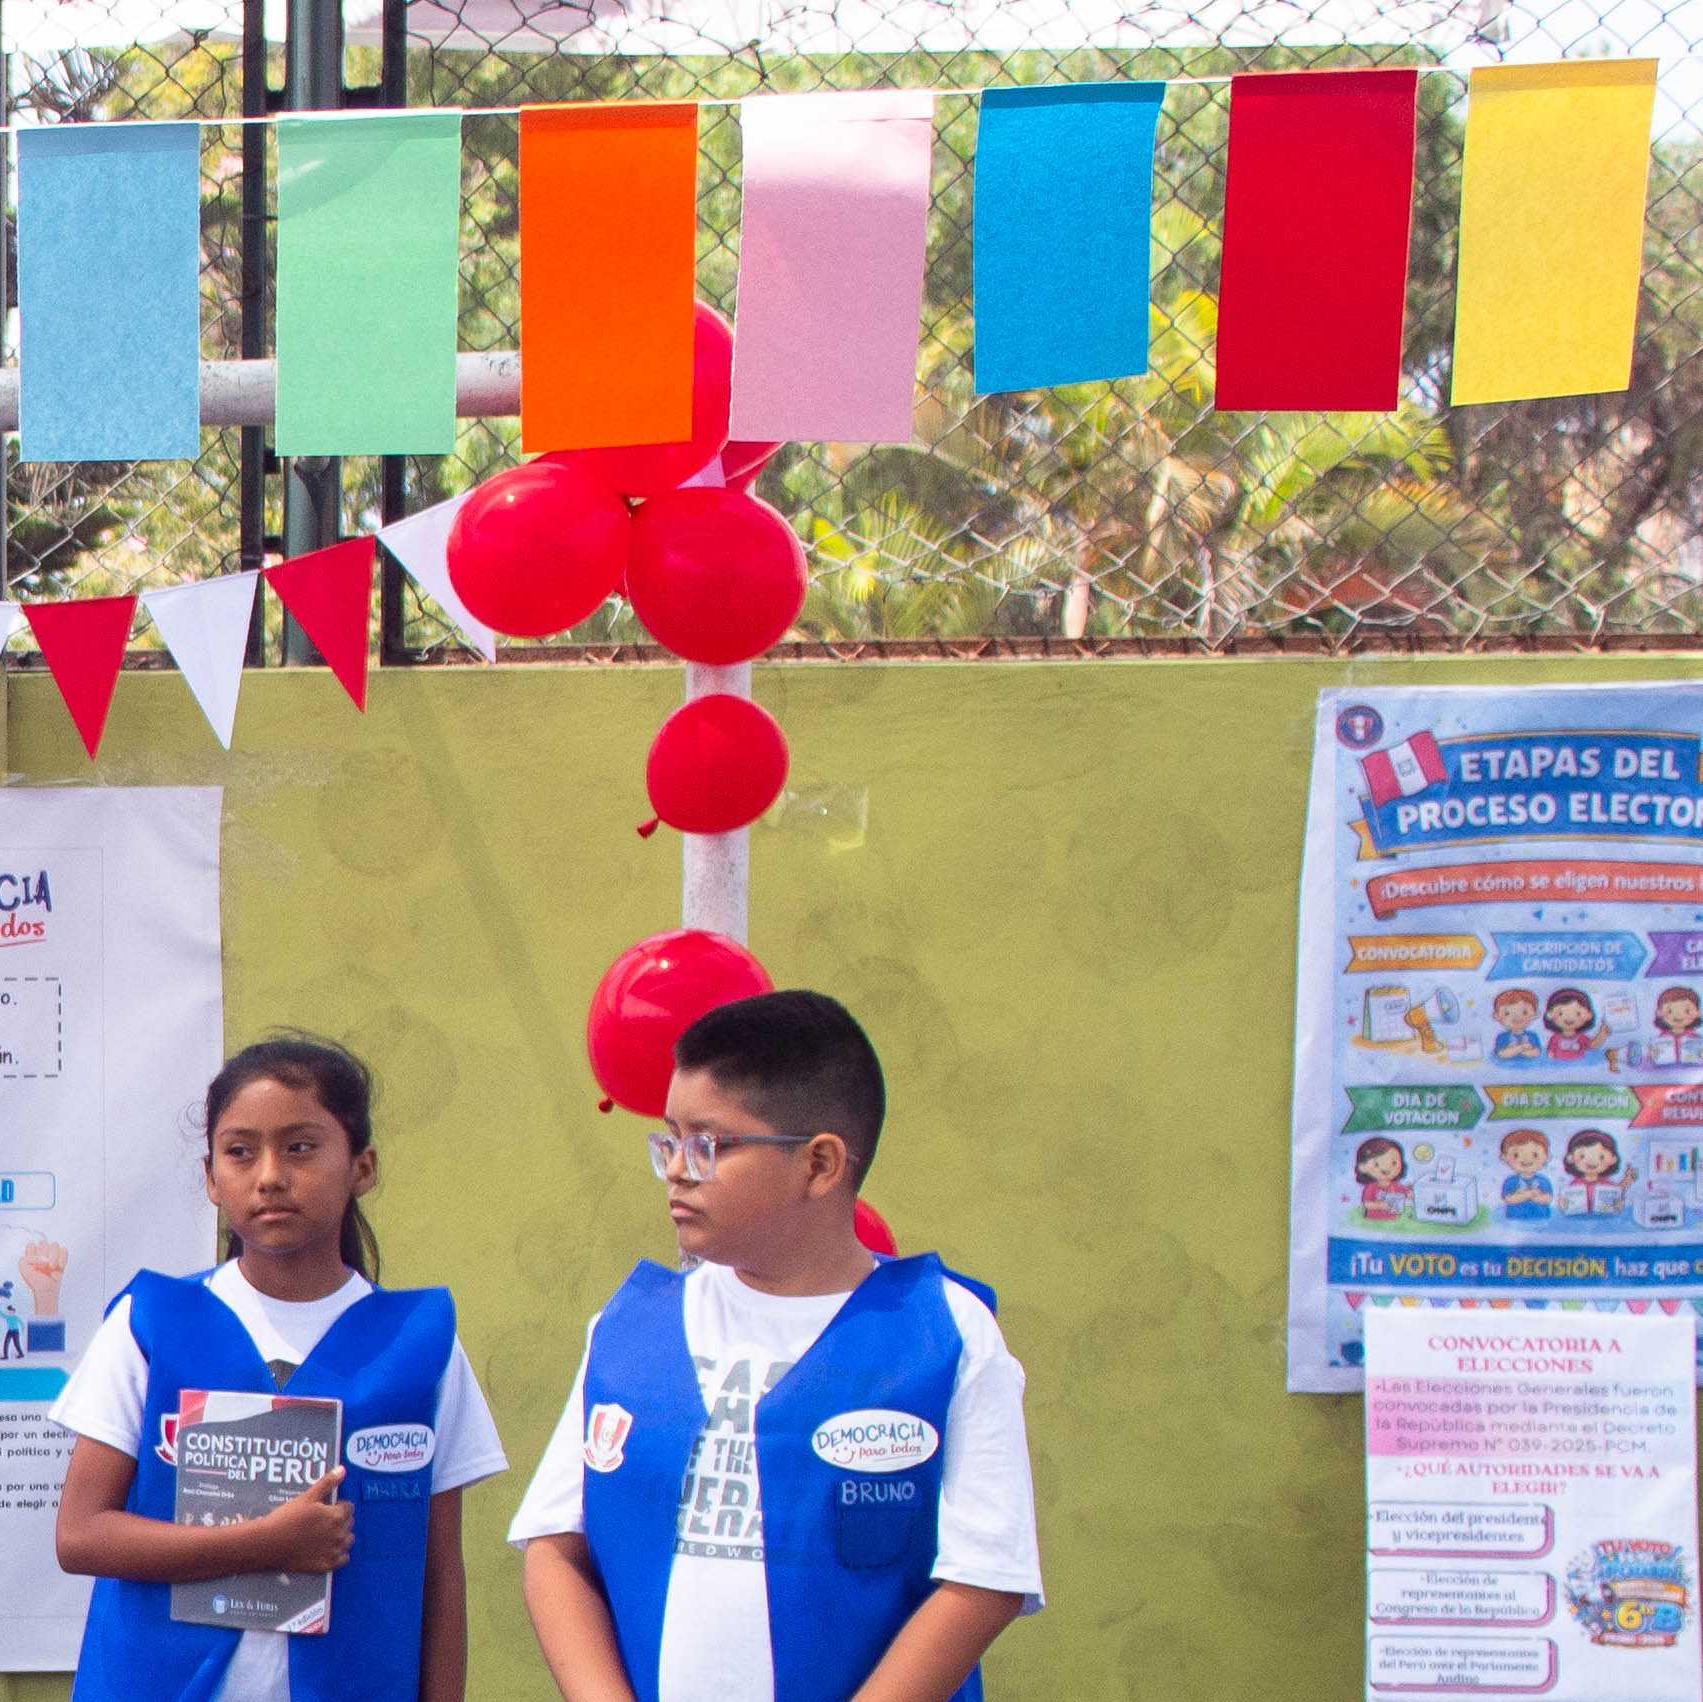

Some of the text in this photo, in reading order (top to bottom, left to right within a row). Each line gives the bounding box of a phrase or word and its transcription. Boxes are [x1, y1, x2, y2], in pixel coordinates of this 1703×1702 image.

[1460, 746, 1681, 783] ETAPAS DEL
[1396, 795, 1558, 835] PROCESO
[1388, 1253, 1457, 1277] VOTO
[1460, 1260, 1480, 1277] es
[1482, 1259, 1503, 1277] tu
[1614, 1256, 1650, 1277] haz
[1653, 1261, 1691, 1281] que
[1427, 1336, 1624, 1354] CONVOCATORIA A
[1456, 1356, 1593, 1374] ELECCIONES
[186, 1432, 328, 1459] CONSTITUCIÓN
[356, 1430, 429, 1452] DEMOCRACIA
[816, 1420, 927, 1451] DEMOCRACIA
[185, 1450, 327, 1485] POLÍTICA PERÚ
[227, 1469, 248, 1481] DEL
[841, 1480, 916, 1505] BRUNO
